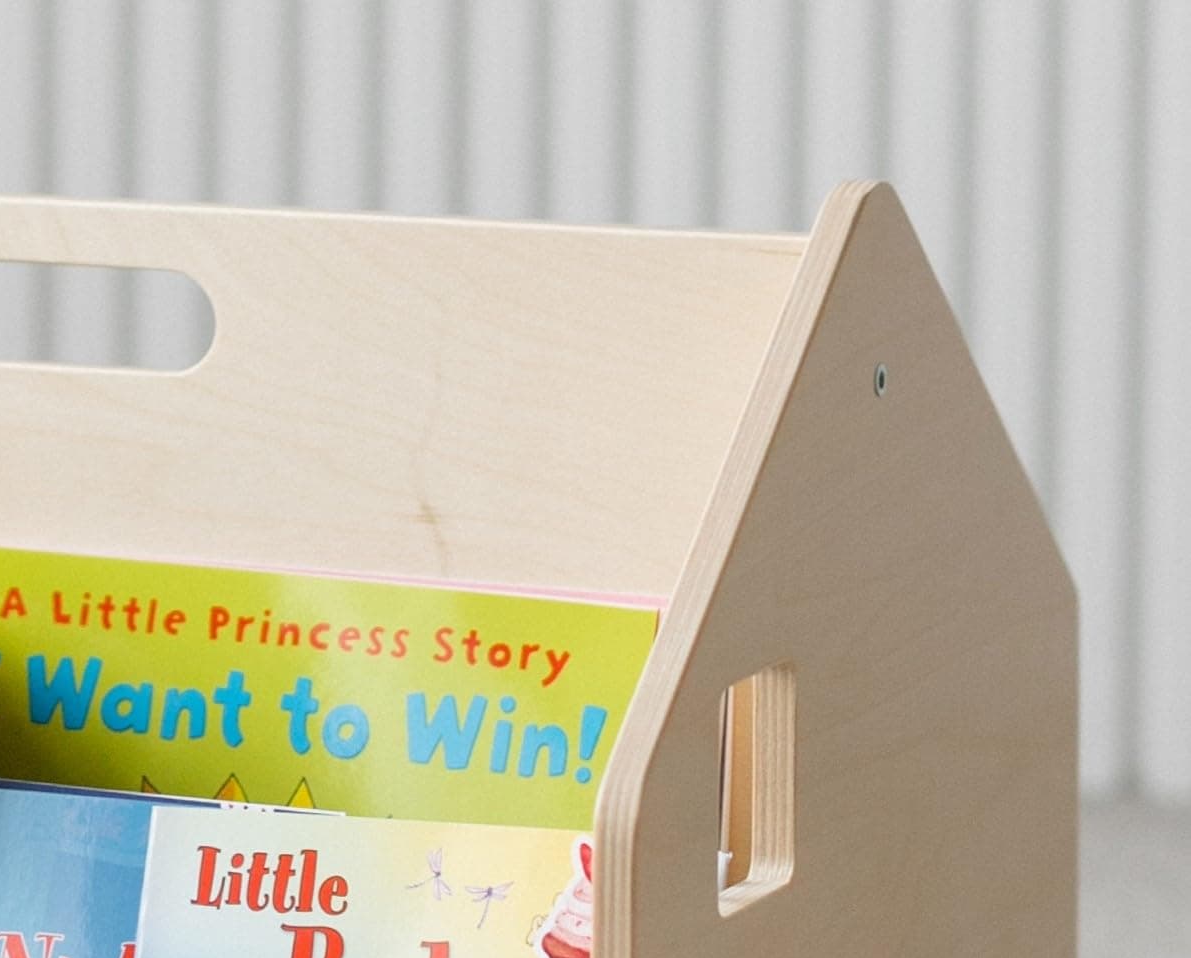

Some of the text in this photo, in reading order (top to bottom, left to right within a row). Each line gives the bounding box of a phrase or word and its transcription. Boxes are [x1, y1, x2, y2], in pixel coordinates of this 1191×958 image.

[0, 586, 571, 687] A Little Princess Story
[26, 653, 252, 749] Want
[281, 676, 370, 760] to
[406, 691, 608, 784] Win!
[190, 844, 350, 915] Little
